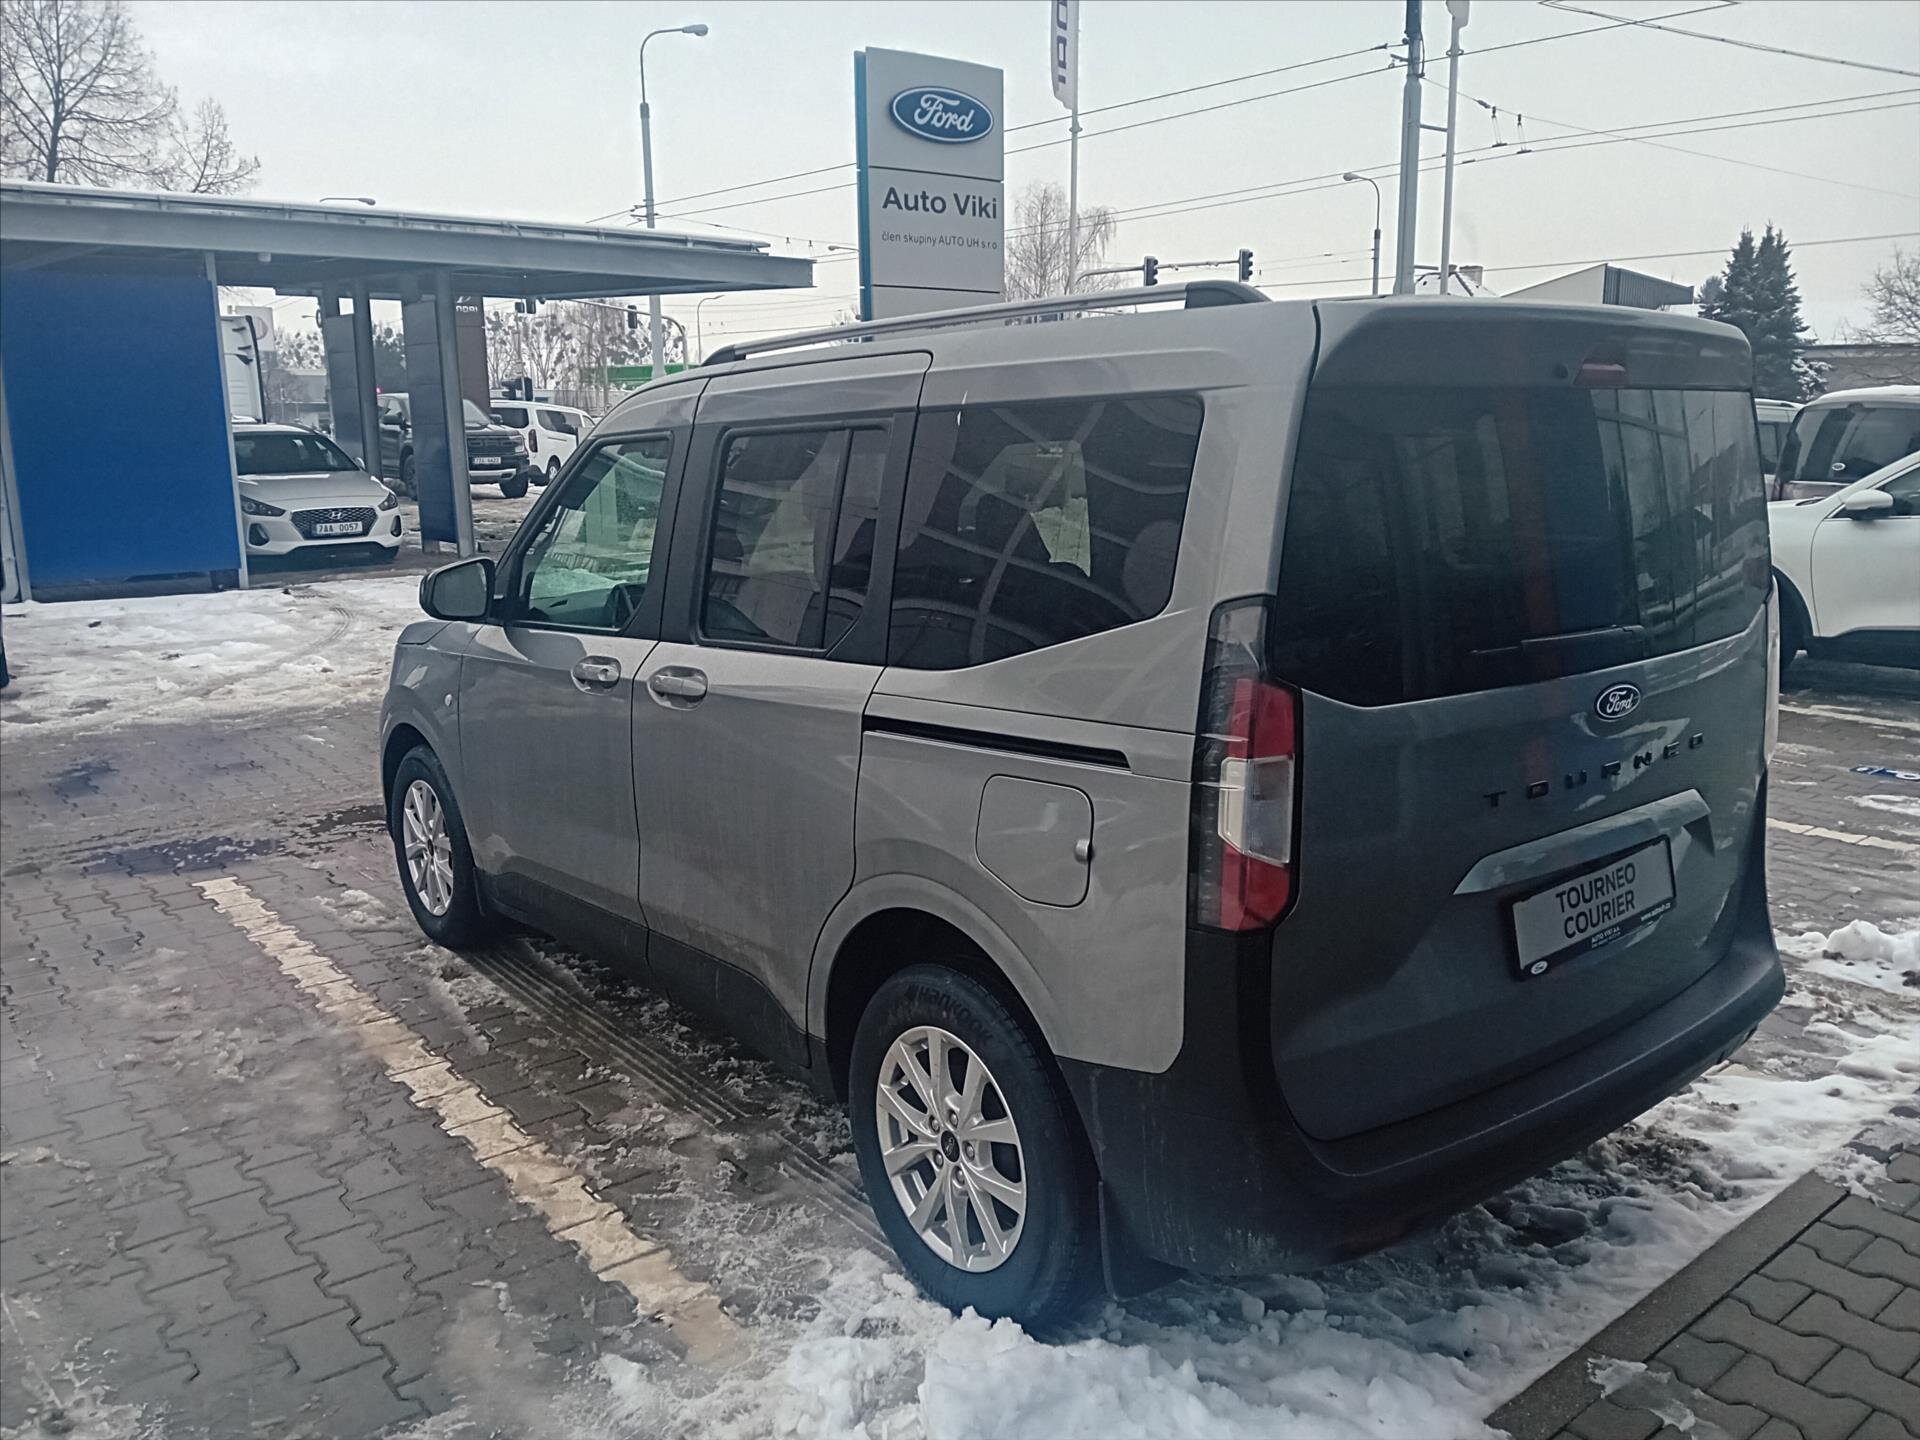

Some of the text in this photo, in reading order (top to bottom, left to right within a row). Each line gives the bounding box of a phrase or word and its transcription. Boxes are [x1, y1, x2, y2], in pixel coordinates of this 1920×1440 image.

[913, 94, 975, 132] Ford
[882, 187, 997, 219] Auto Viki
[881, 231, 901, 242] člen
[903, 233, 937, 248] skupiny
[939, 235, 965, 247] AUTO
[966, 237, 980, 248] UH
[1606, 690, 1634, 713] Ford
[1483, 733, 1704, 808] TOURNEO
[1555, 862, 1636, 913] TOURNEO
[1564, 890, 1635, 939] COURIER
